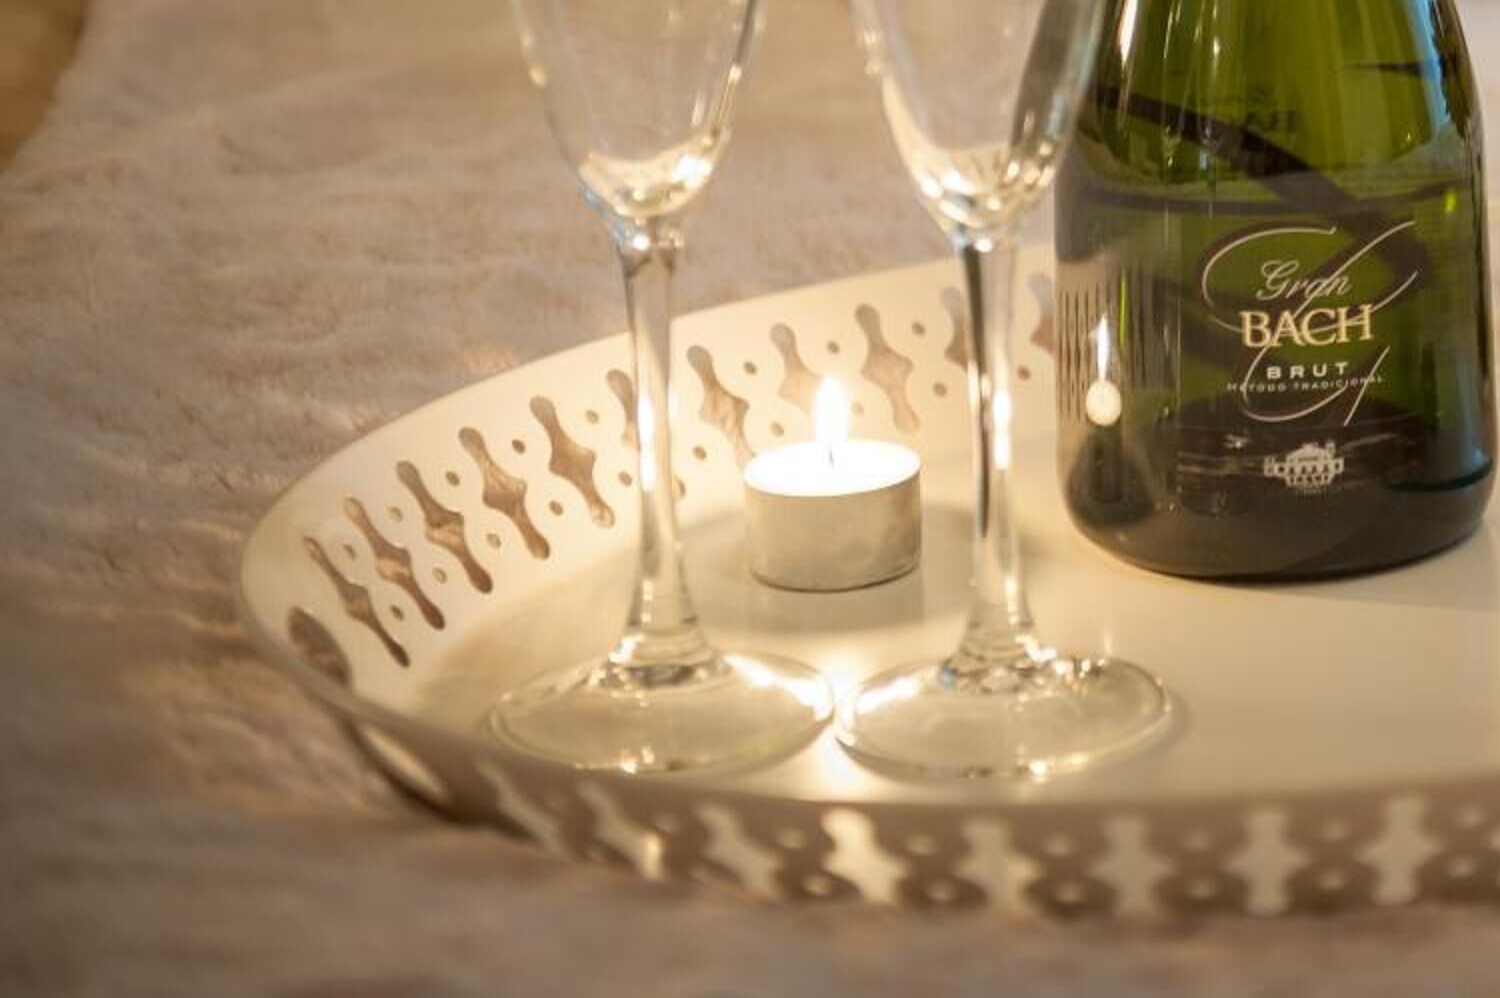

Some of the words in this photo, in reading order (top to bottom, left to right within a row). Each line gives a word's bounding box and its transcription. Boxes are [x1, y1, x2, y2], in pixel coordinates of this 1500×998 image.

[1256, 260, 1351, 300] Gran
[1240, 304, 1374, 347] BACH
[1266, 361, 1349, 379] BRUT
